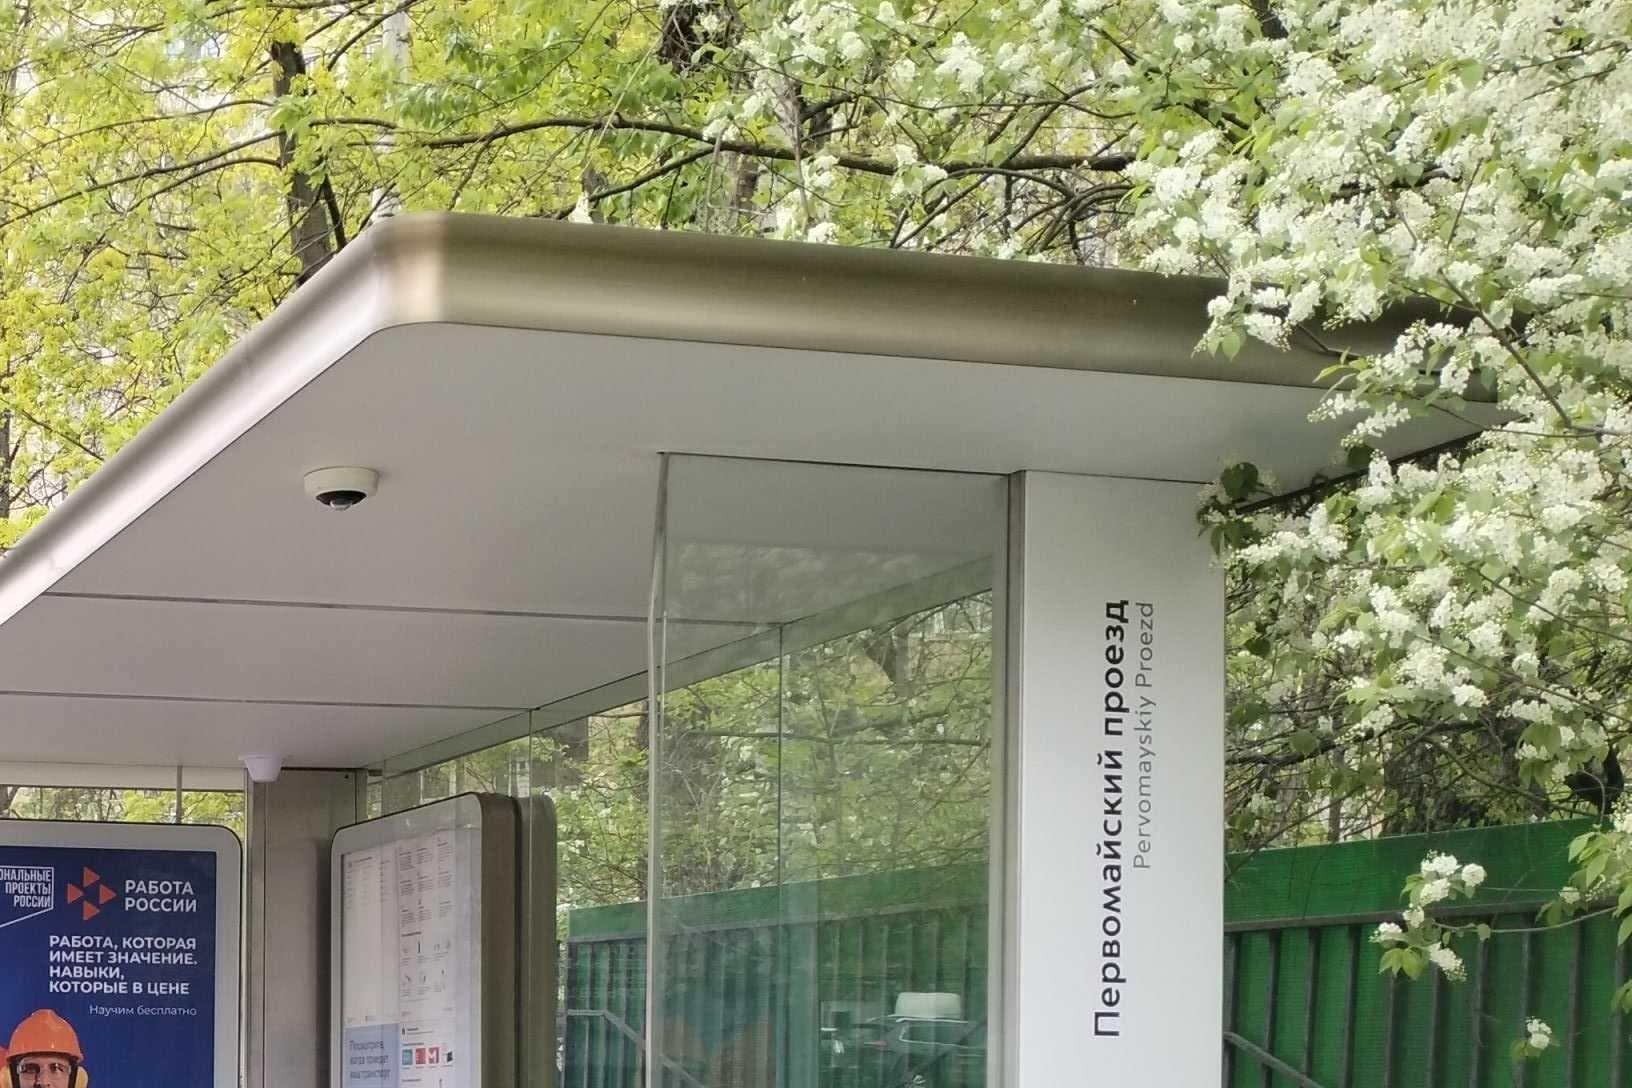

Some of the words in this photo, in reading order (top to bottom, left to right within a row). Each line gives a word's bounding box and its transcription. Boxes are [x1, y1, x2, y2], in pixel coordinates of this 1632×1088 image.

[1135, 602, 1155, 687] Proezd
[1104, 599, 1130, 736] проезд
[1133, 695, 1157, 869] Pervomayskiy
[4, 882, 52, 895] ПРОЕКТЫ
[124, 879, 194, 895] РАБОТА
[1093, 749, 1128, 1037] Первомайский
[13, 895, 52, 908] РОССИИ
[124, 897, 197, 912] РОССИИ
[49, 935, 118, 949] РАБОТА,
[122, 937, 197, 950] КОТОРАЯ
[49, 951, 104, 963] ИМЕЕТ
[108, 951, 198, 965] ЗНАЧЕНИЕ.
[49, 966, 125, 980] НАВЫКИ,
[49, 981, 128, 994] КОТОРЫЕ
[132, 982, 143, 994] В
[147, 982, 190, 996] ЦЕНЕ
[89, 1005, 135, 1017] Научим
[137, 1005, 198, 1016] бесплатно
